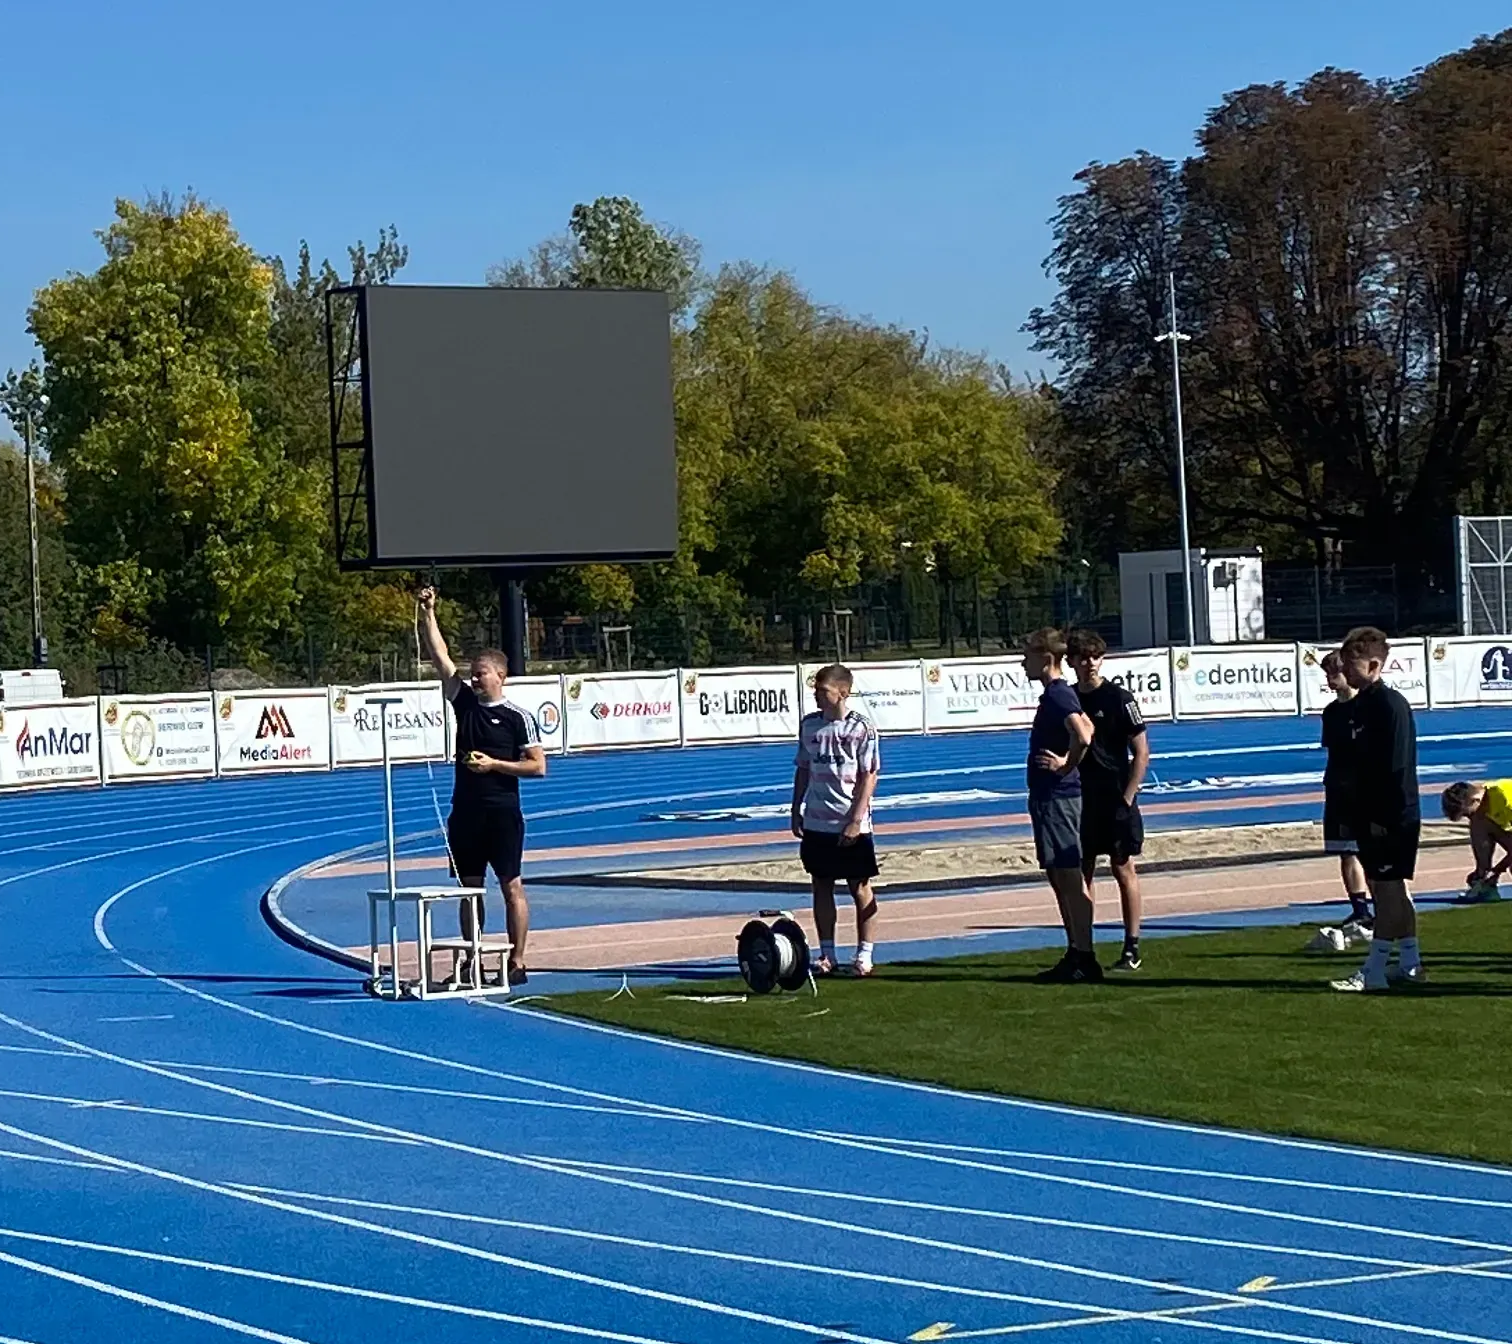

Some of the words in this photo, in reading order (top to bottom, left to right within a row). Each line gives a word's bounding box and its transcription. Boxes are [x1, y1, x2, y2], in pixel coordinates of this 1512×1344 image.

[948, 671, 1033, 694] VERONA
[1194, 663, 1292, 686] edentika
[613, 701, 672, 718] DERKOM
[20, 727, 92, 758] AnMar
[239, 744, 312, 762] MediaAlert
